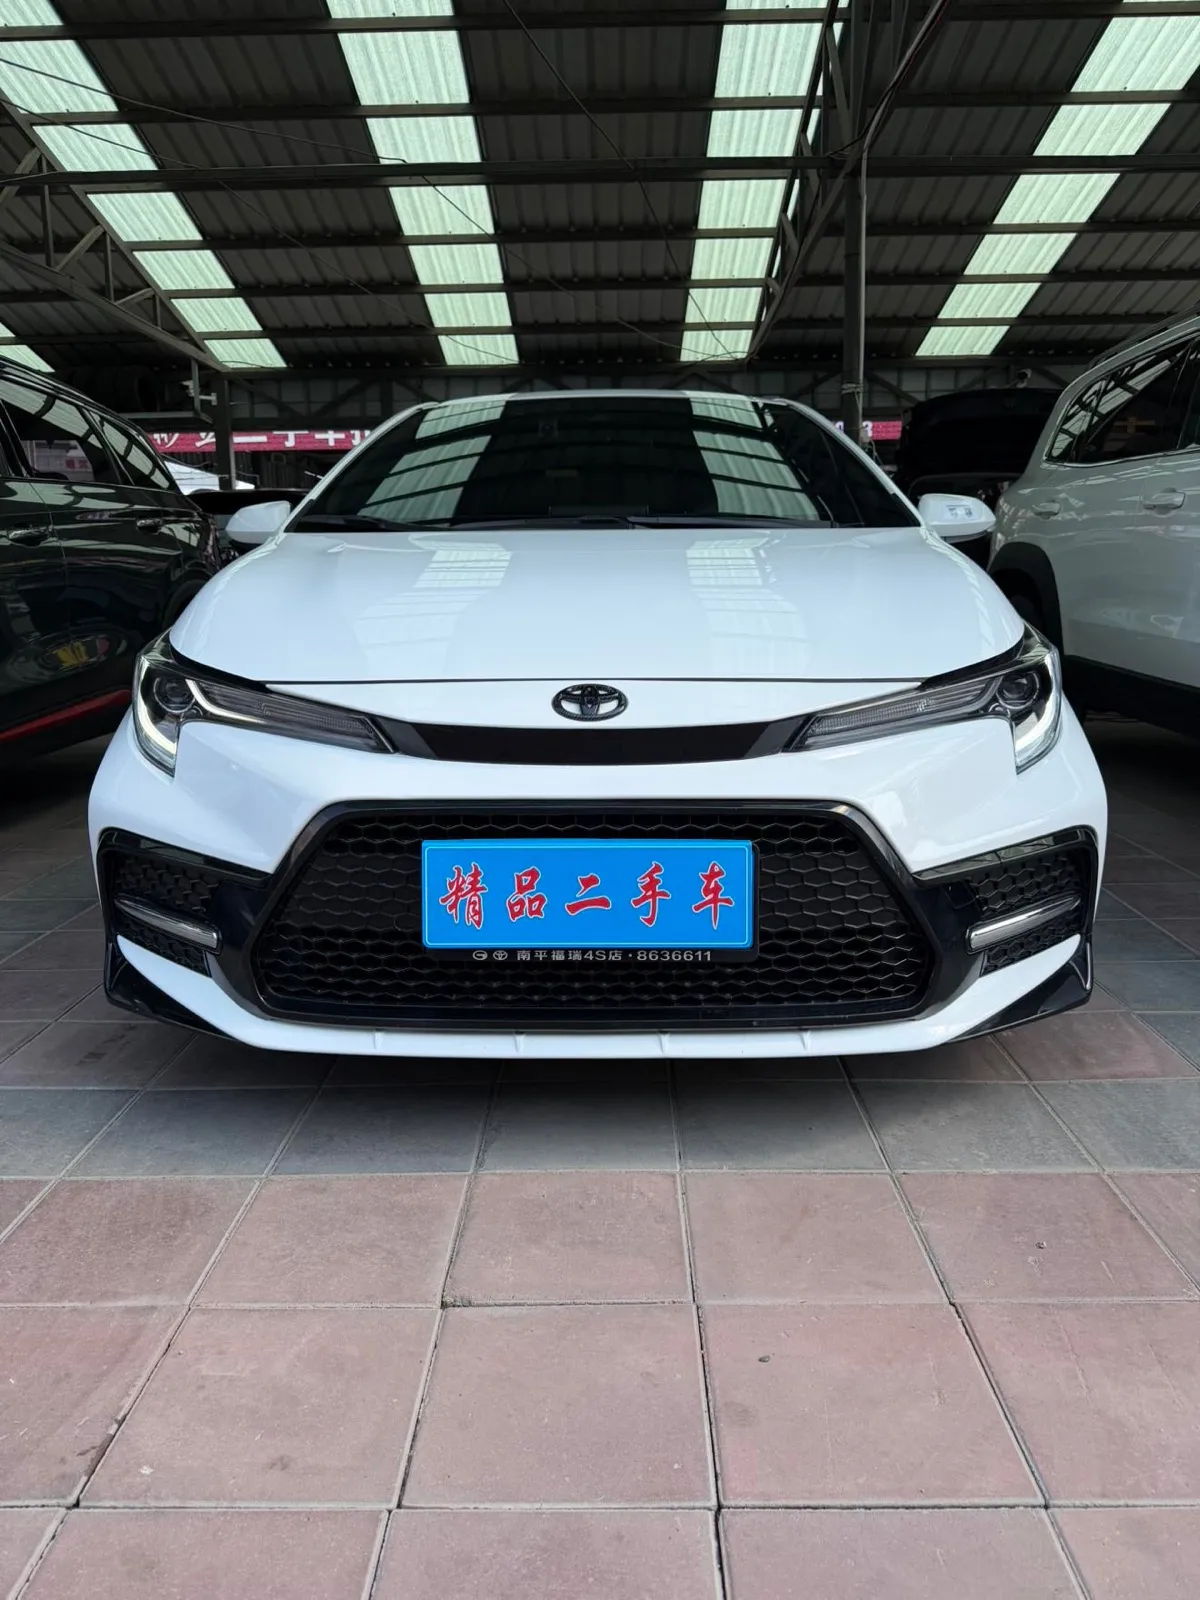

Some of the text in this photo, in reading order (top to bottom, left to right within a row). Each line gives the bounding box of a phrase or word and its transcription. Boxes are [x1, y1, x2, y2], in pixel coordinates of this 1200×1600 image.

[439, 862, 735, 930] 精品二手车
